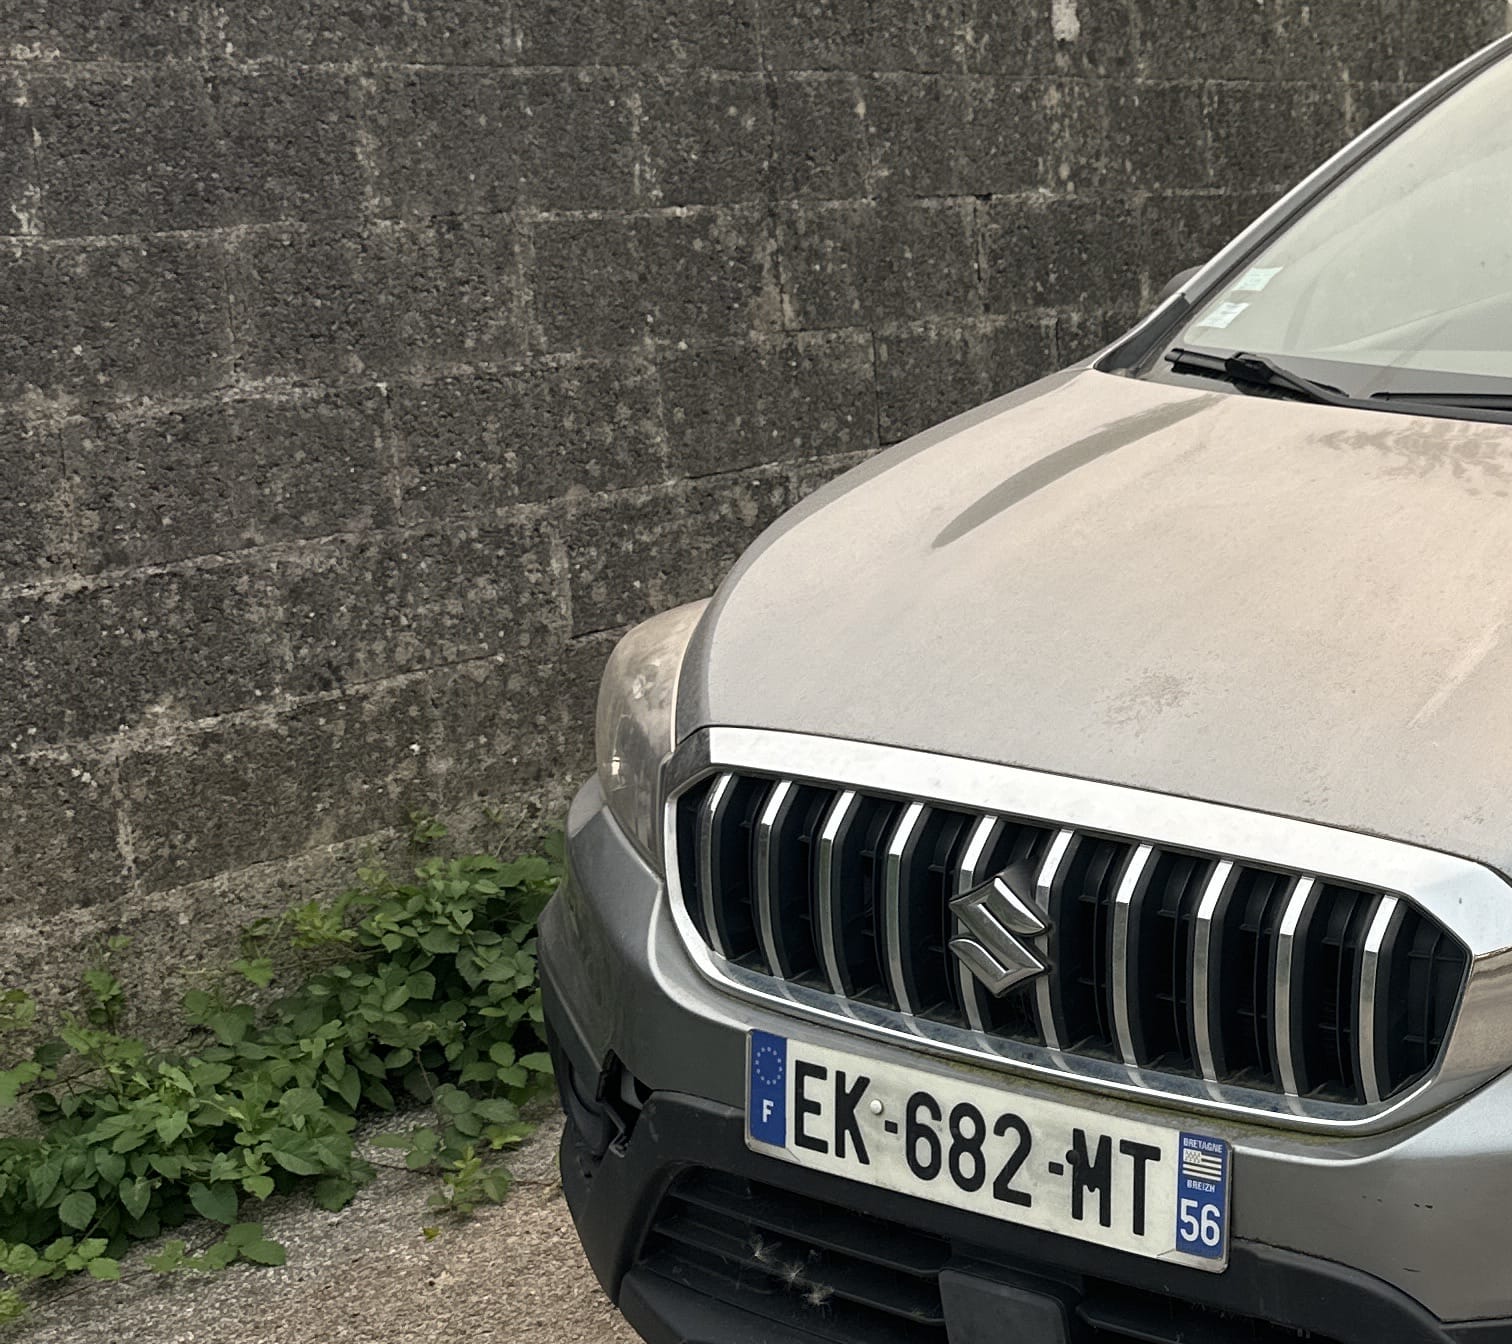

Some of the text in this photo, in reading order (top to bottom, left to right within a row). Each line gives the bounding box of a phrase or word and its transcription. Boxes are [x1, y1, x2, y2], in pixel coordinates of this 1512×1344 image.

[762, 1099, 774, 1123] F
[794, 1059, 1161, 1236] EK-682-MT
[1183, 1137, 1223, 1153] BRETAGNE
[1187, 1179, 1216, 1193] BREIZH
[1180, 1198, 1221, 1247] 56
